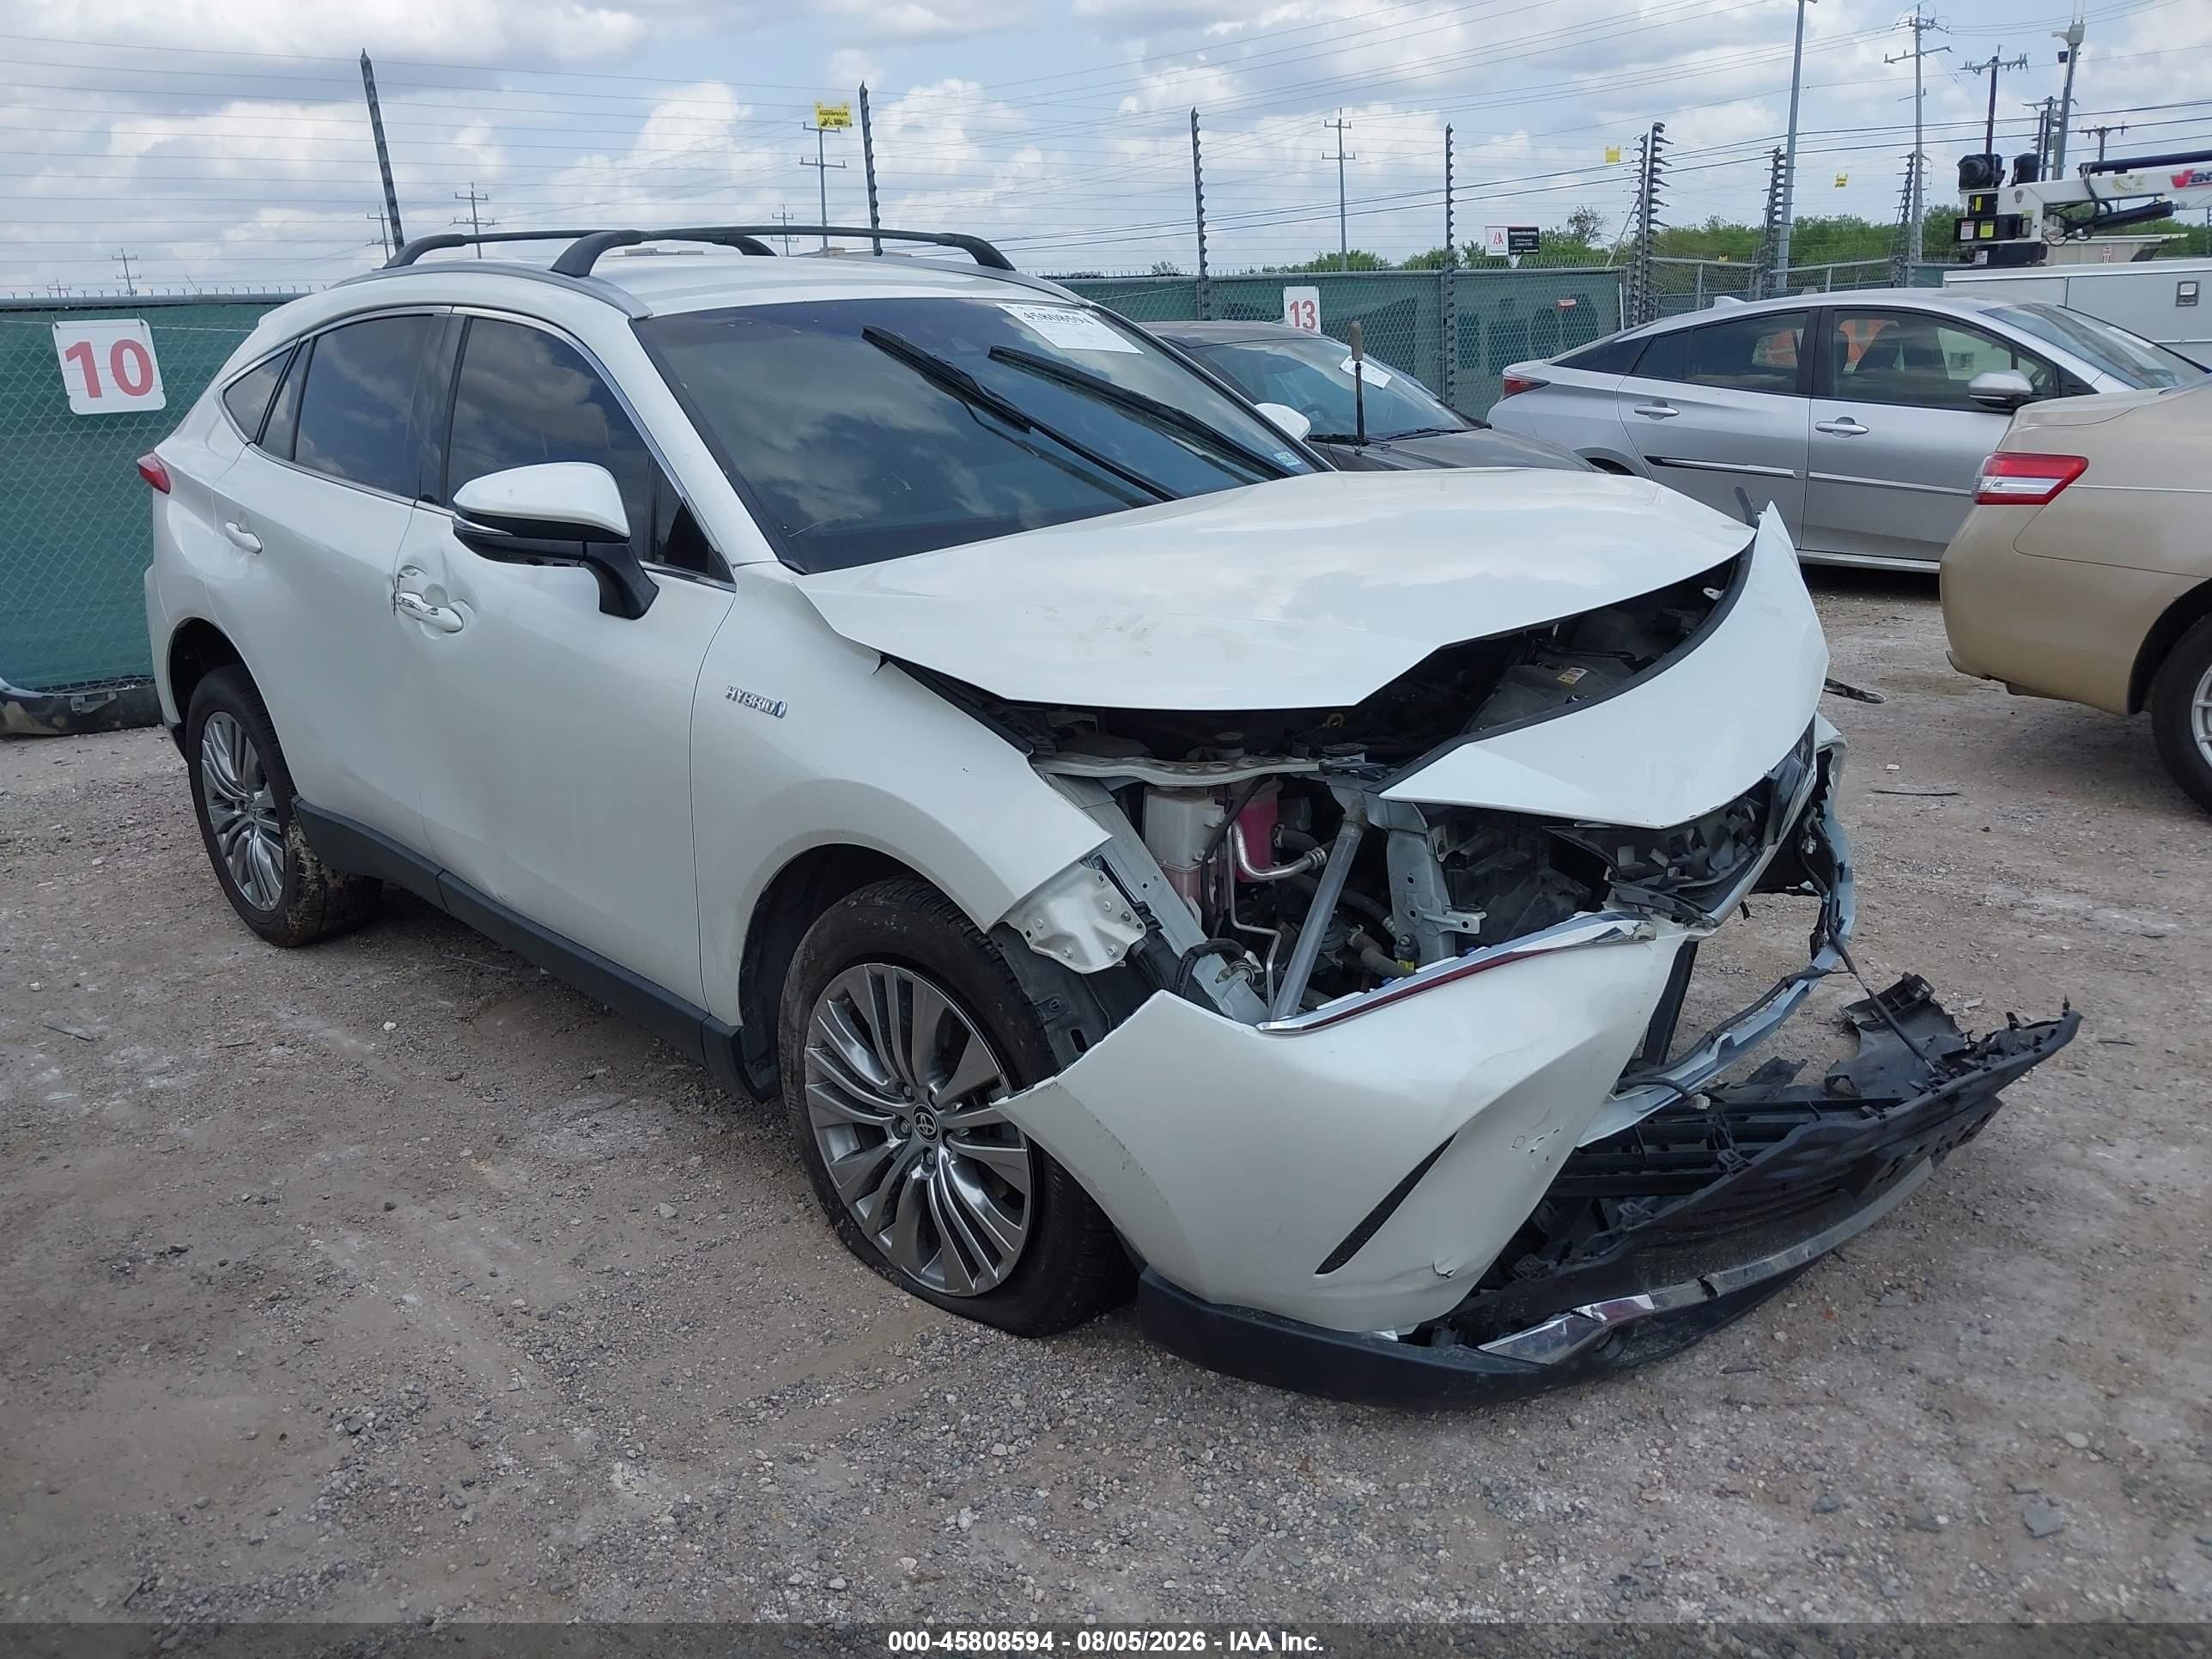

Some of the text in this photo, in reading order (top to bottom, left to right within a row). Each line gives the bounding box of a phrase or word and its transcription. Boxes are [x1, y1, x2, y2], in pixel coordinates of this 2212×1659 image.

[1289, 300, 1316, 331] 13
[64, 338, 154, 398] 10
[725, 685, 777, 714] HYBRID
